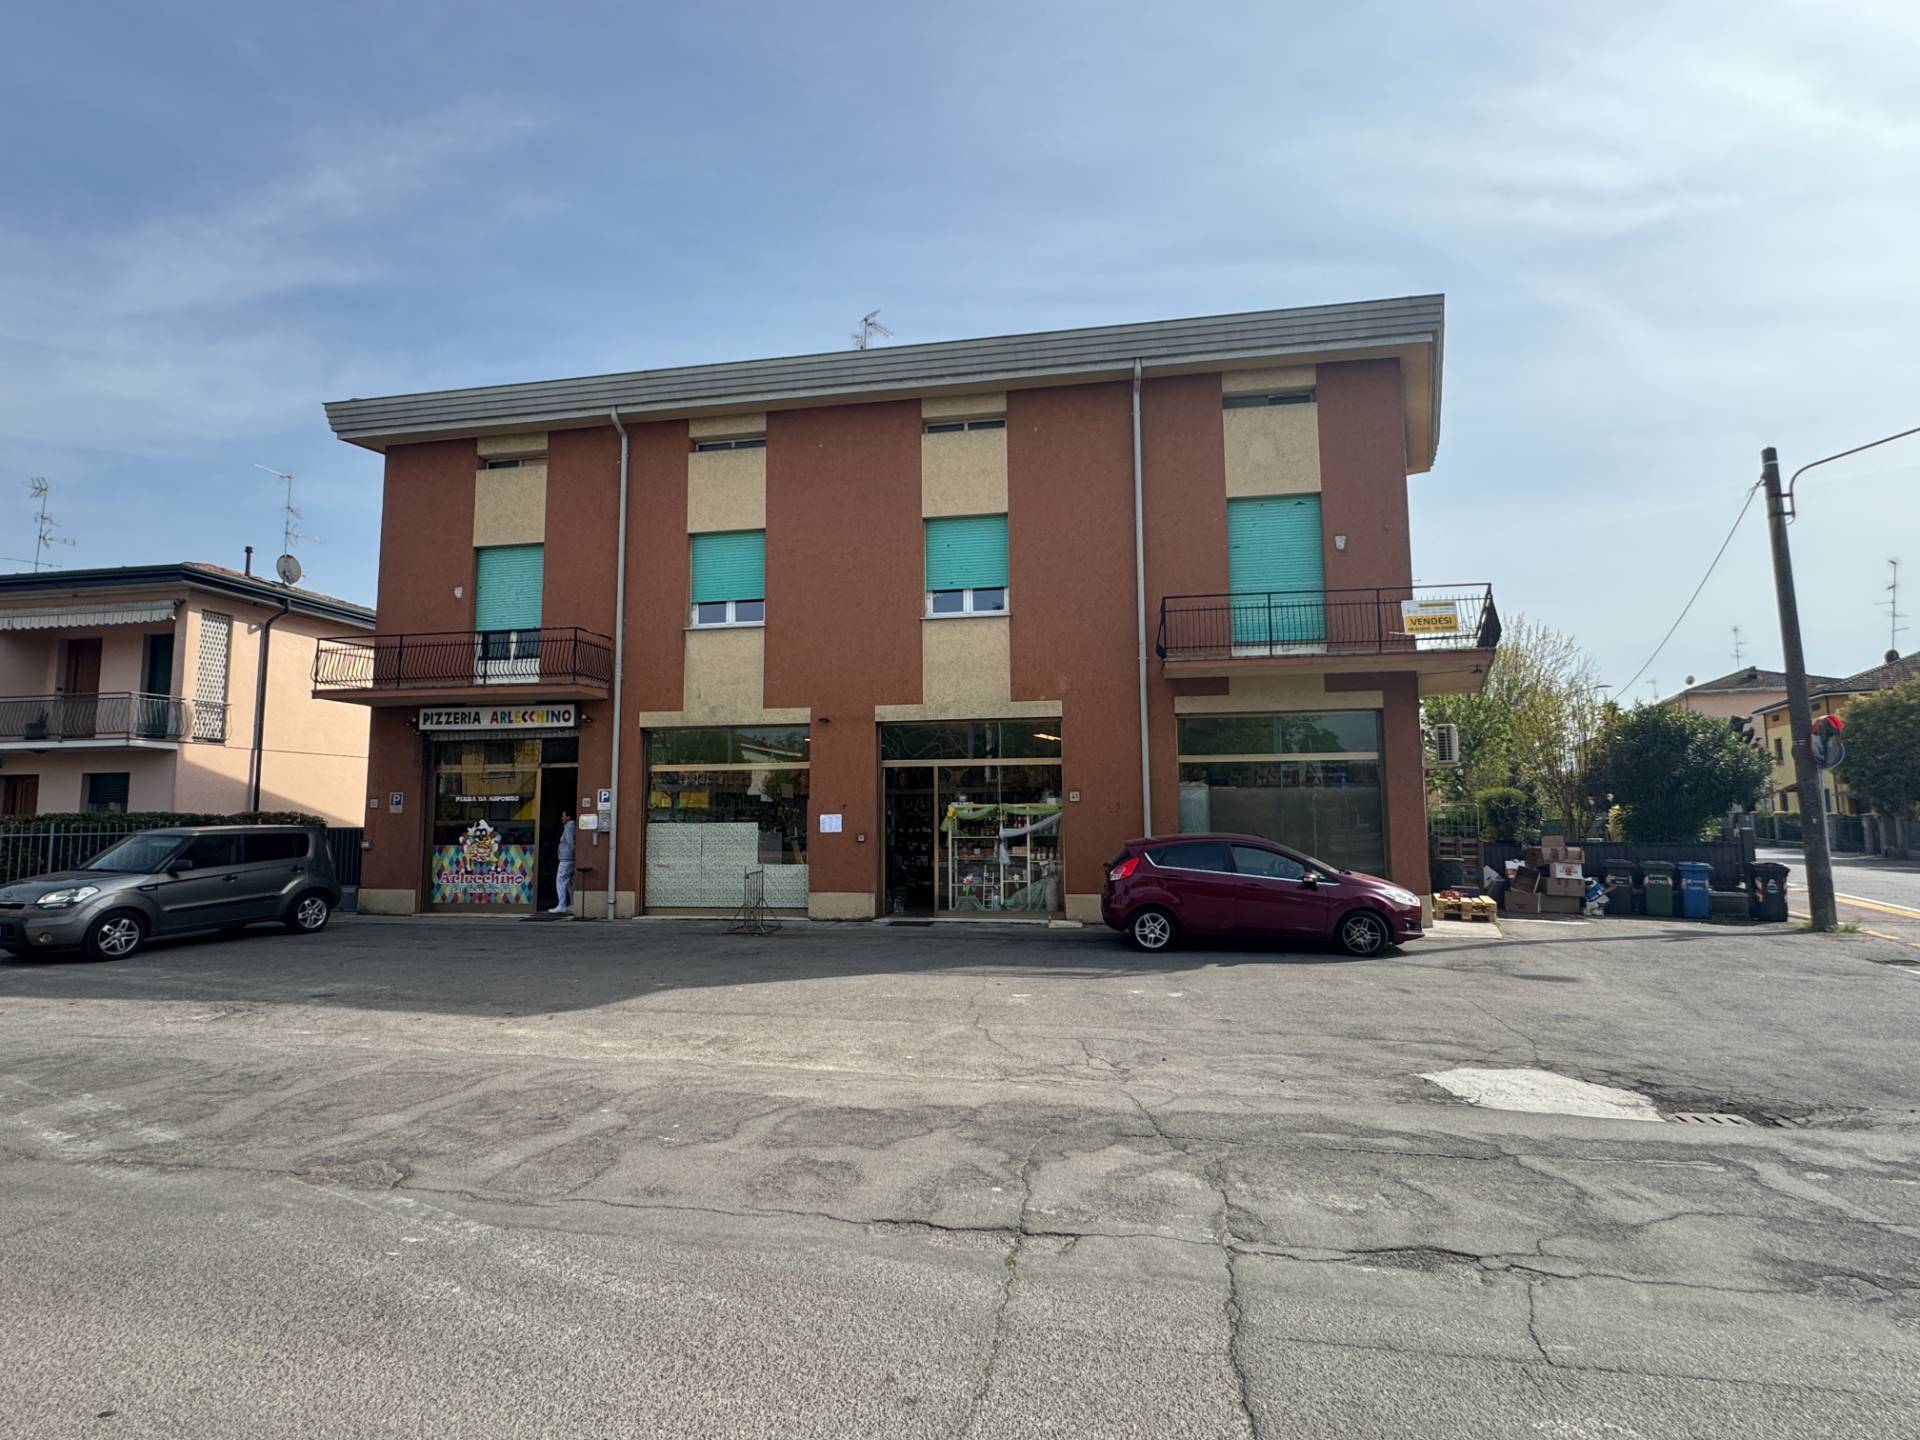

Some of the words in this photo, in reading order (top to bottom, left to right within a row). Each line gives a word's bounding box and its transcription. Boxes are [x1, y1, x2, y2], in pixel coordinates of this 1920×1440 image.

[1410, 616, 1452, 625] VENDESI
[422, 711, 481, 726] PIZZERIA
[489, 709, 572, 725] ARLECCHINO
[393, 794, 401, 805] P
[601, 791, 609, 802] P
[439, 871, 525, 885] Arlecchino
